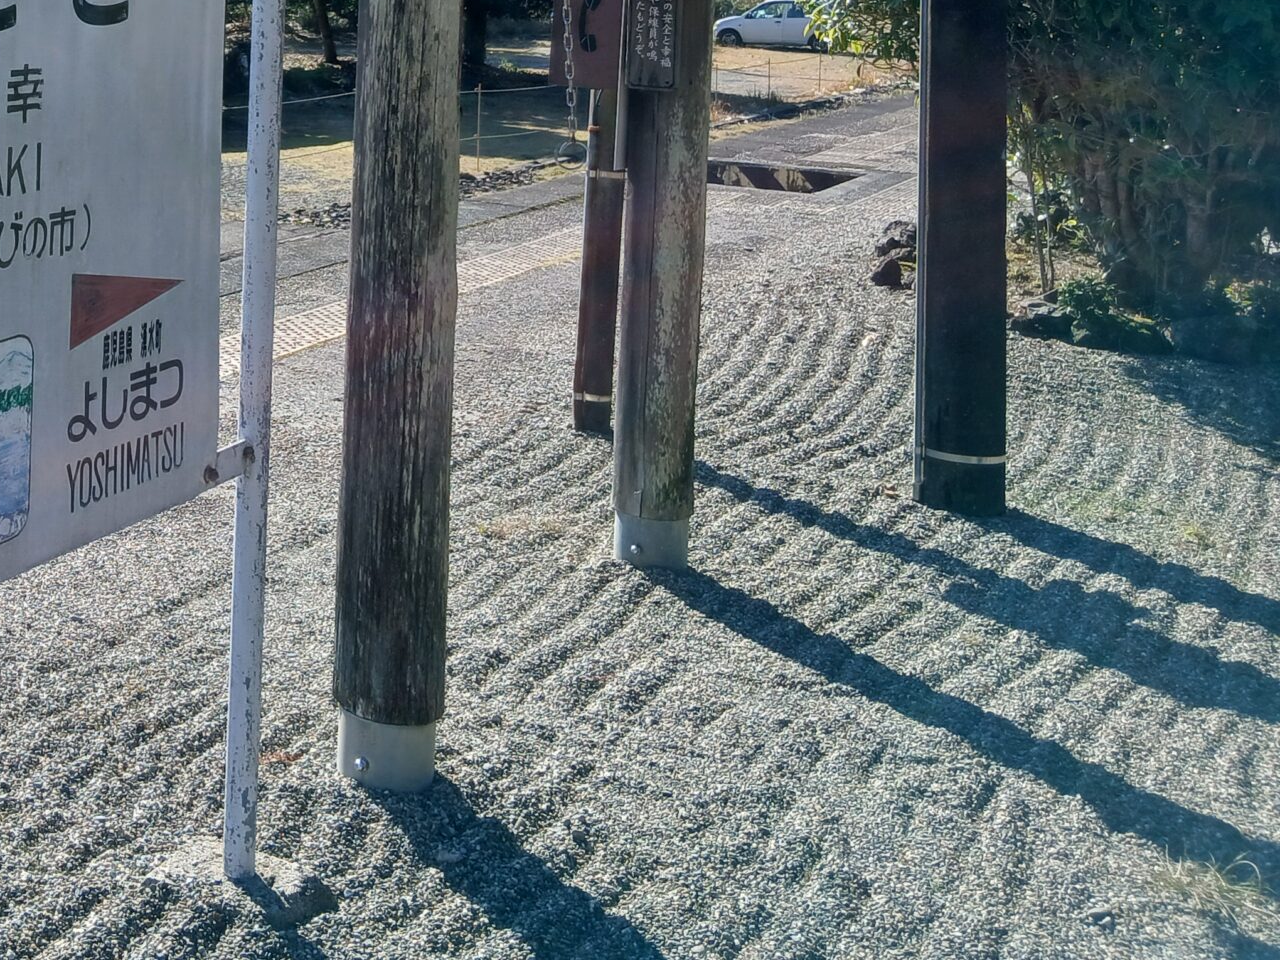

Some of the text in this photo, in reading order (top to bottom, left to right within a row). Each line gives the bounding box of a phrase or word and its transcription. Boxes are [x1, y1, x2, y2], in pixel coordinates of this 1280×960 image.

[102, 326, 133, 370] 鹿児島県
[67, 358, 184, 442] よしまつ
[66, 421, 184, 513] YOSHIMATSU
